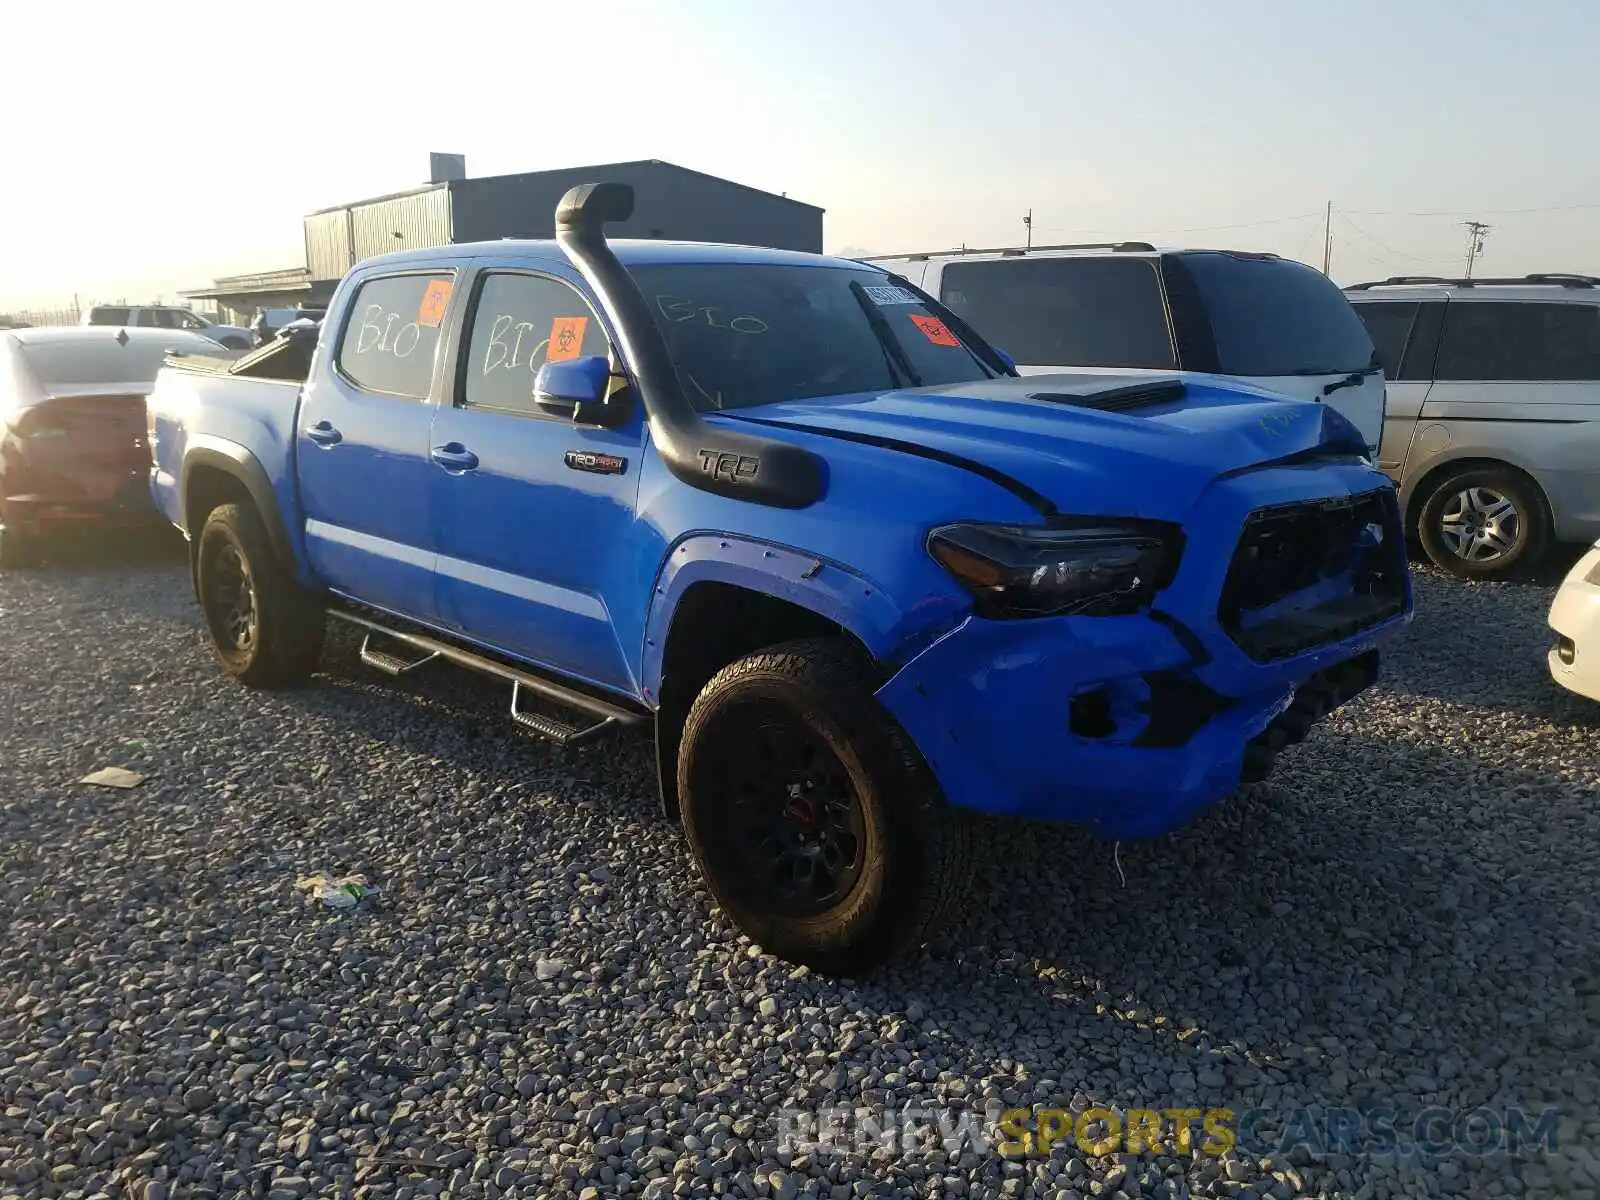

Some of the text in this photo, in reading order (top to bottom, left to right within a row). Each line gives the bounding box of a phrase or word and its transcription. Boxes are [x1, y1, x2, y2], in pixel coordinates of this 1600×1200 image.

[357, 304, 420, 357] BIO
[656, 294, 769, 334] BIO
[566, 451, 596, 466] TRD
[699, 449, 760, 482] TRD
